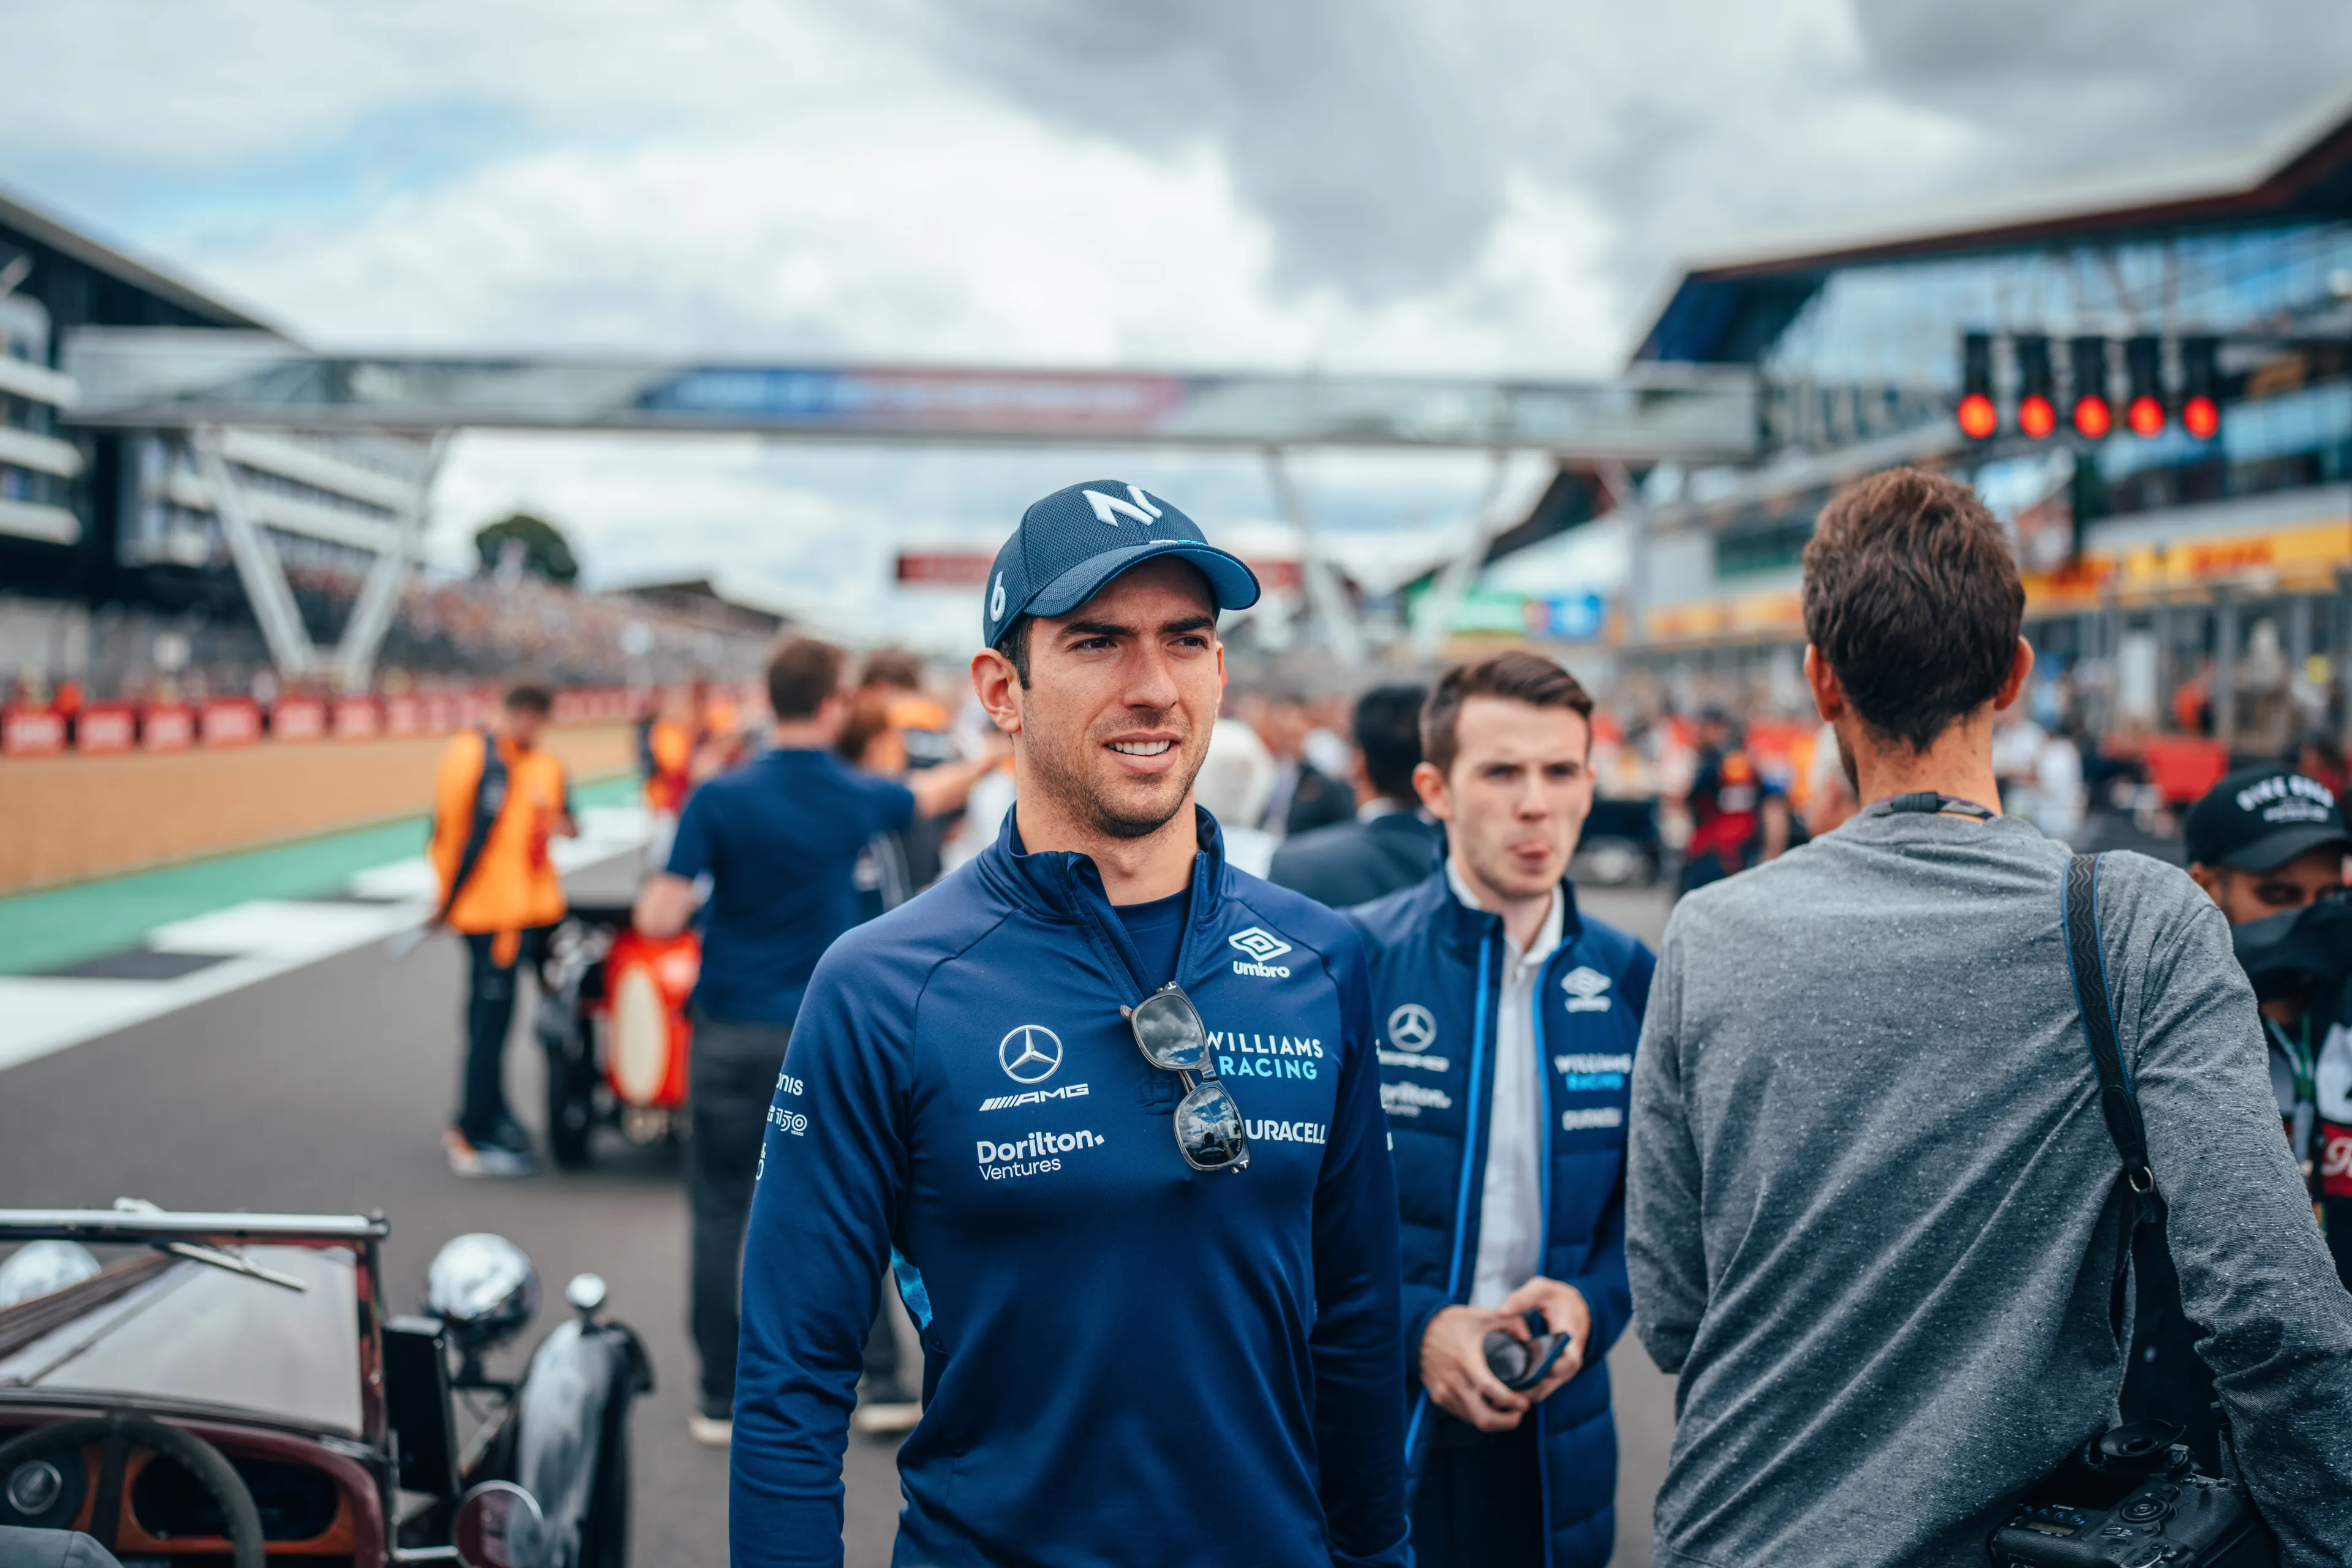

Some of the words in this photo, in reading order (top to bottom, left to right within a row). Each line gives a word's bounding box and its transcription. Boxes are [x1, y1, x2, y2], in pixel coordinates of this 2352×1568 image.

[990, 571, 1006, 623] 6
[1233, 961, 1291, 978] umbro
[1207, 1031, 1324, 1058] WILLIAMS
[1219, 1055, 1317, 1080] RACING
[979, 1158, 1061, 1180] Ventures
